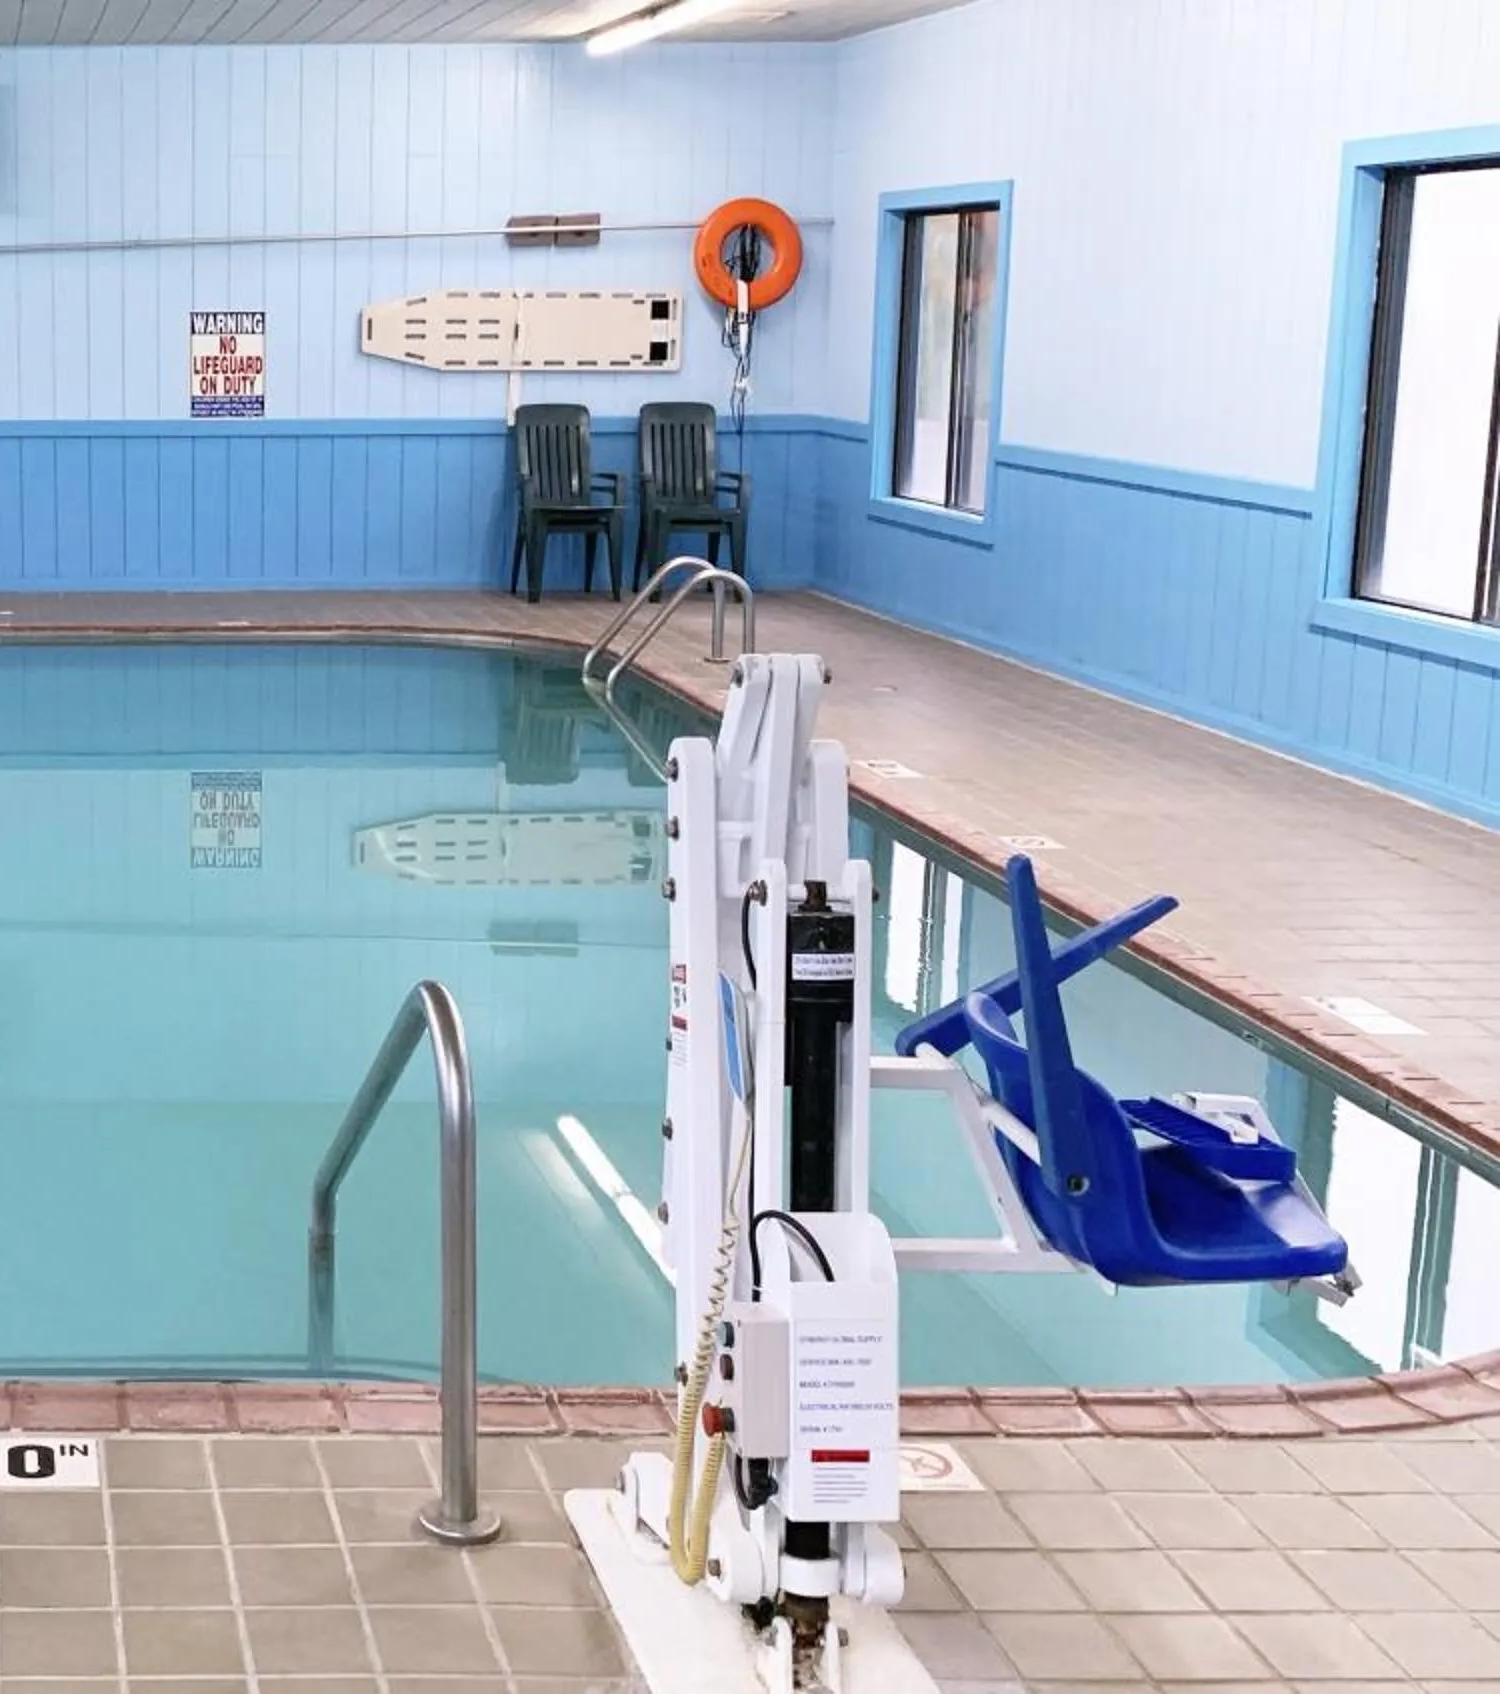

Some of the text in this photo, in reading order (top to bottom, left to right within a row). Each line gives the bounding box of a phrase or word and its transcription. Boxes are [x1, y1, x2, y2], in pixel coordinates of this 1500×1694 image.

[192, 313, 263, 333] WARNING
[220, 336, 236, 354] NO
[193, 356, 263, 374] LIFEGUARD
[200, 376, 256, 394] ON DUTY
[8, 1444, 56, 1479] 0
[60, 1444, 89, 1457] IN
